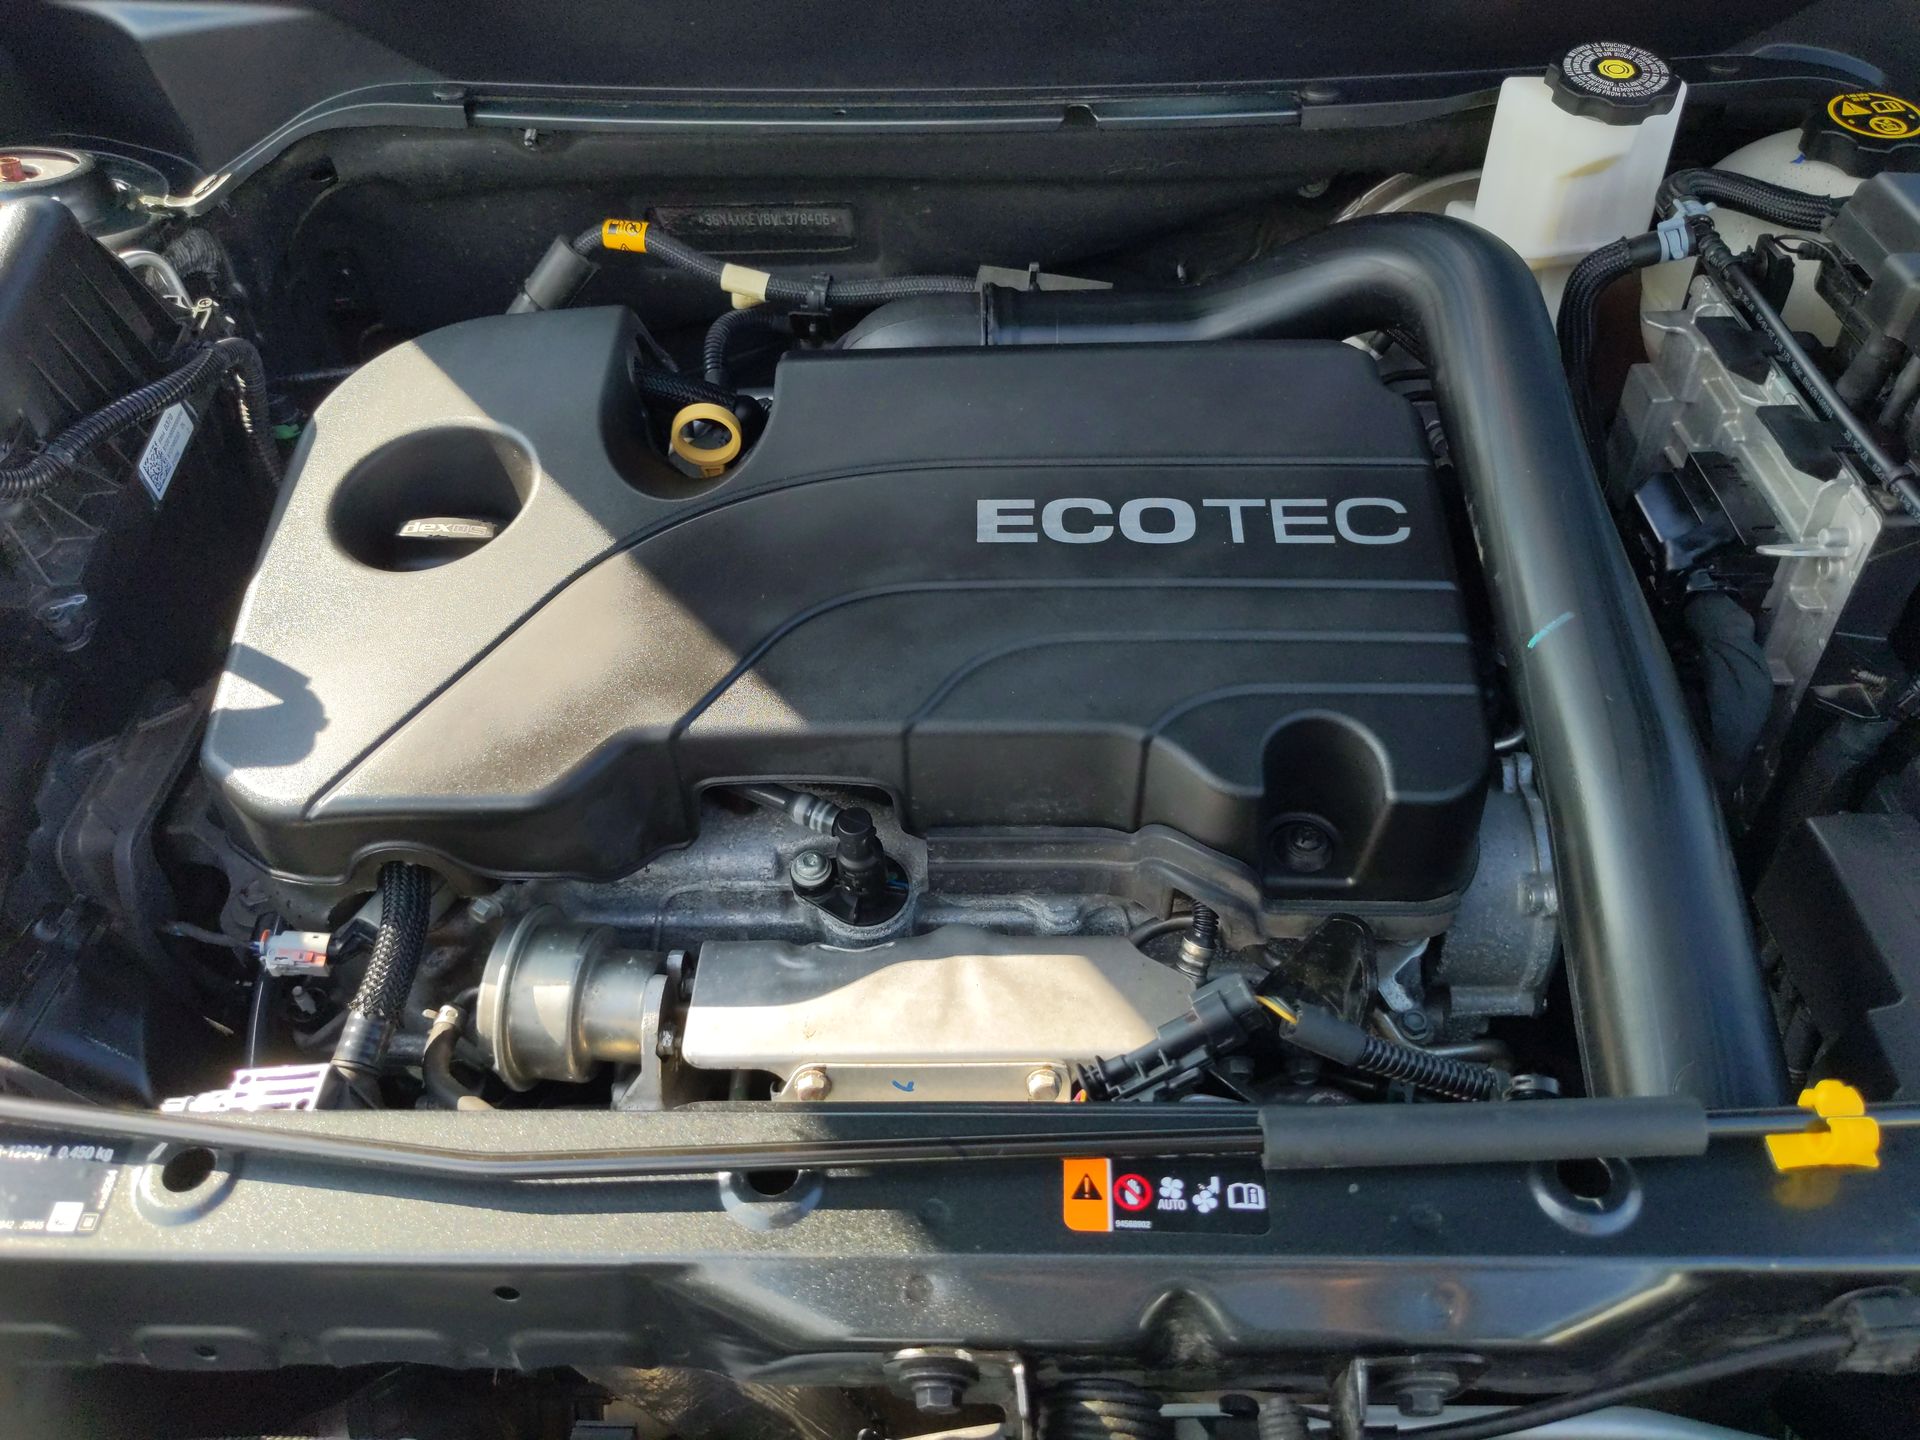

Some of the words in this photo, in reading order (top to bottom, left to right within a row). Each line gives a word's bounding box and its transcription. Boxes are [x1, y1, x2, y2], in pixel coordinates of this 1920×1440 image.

[1583, 84, 1601, 93] FLUID
[1587, 80, 1611, 90] BEFORE
[977, 497, 1411, 544] ECOTEC
[403, 521, 488, 537] dexos
[57, 1145, 95, 1160] 0.450
[95, 1146, 115, 1162] kg
[1157, 1199, 1187, 1211] AUTO
